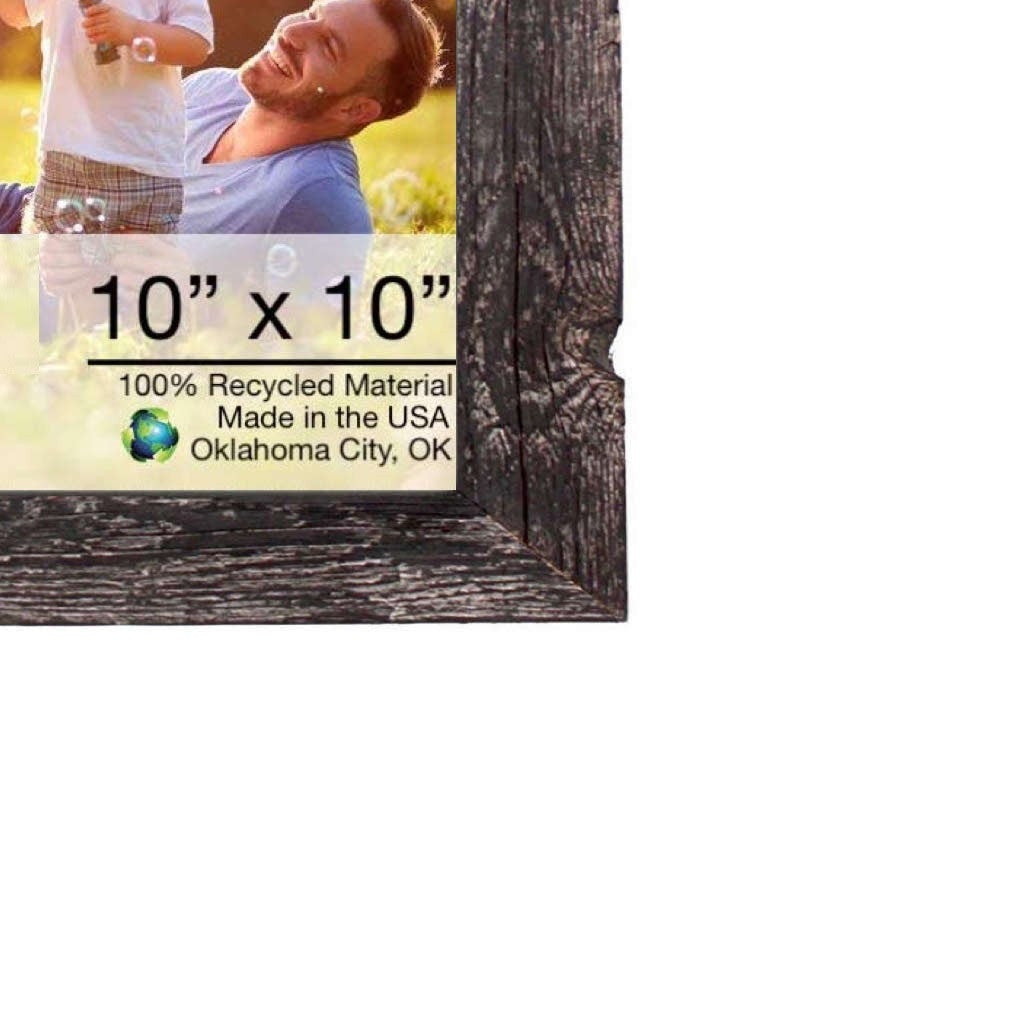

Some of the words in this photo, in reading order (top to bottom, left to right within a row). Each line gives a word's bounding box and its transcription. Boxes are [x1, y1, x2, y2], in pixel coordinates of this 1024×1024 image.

[248, 291, 292, 340] x
[119, 373, 197, 397] 100%
[209, 373, 334, 402] Recycled
[345, 373, 453, 397] Material
[218, 405, 294, 429] Made
[304, 405, 326, 428] in
[335, 405, 378, 429] the
[388, 405, 450, 429] USA
[191, 437, 330, 462] Oklahoma
[339, 437, 398, 466] City,
[408, 437, 452, 462] OK
